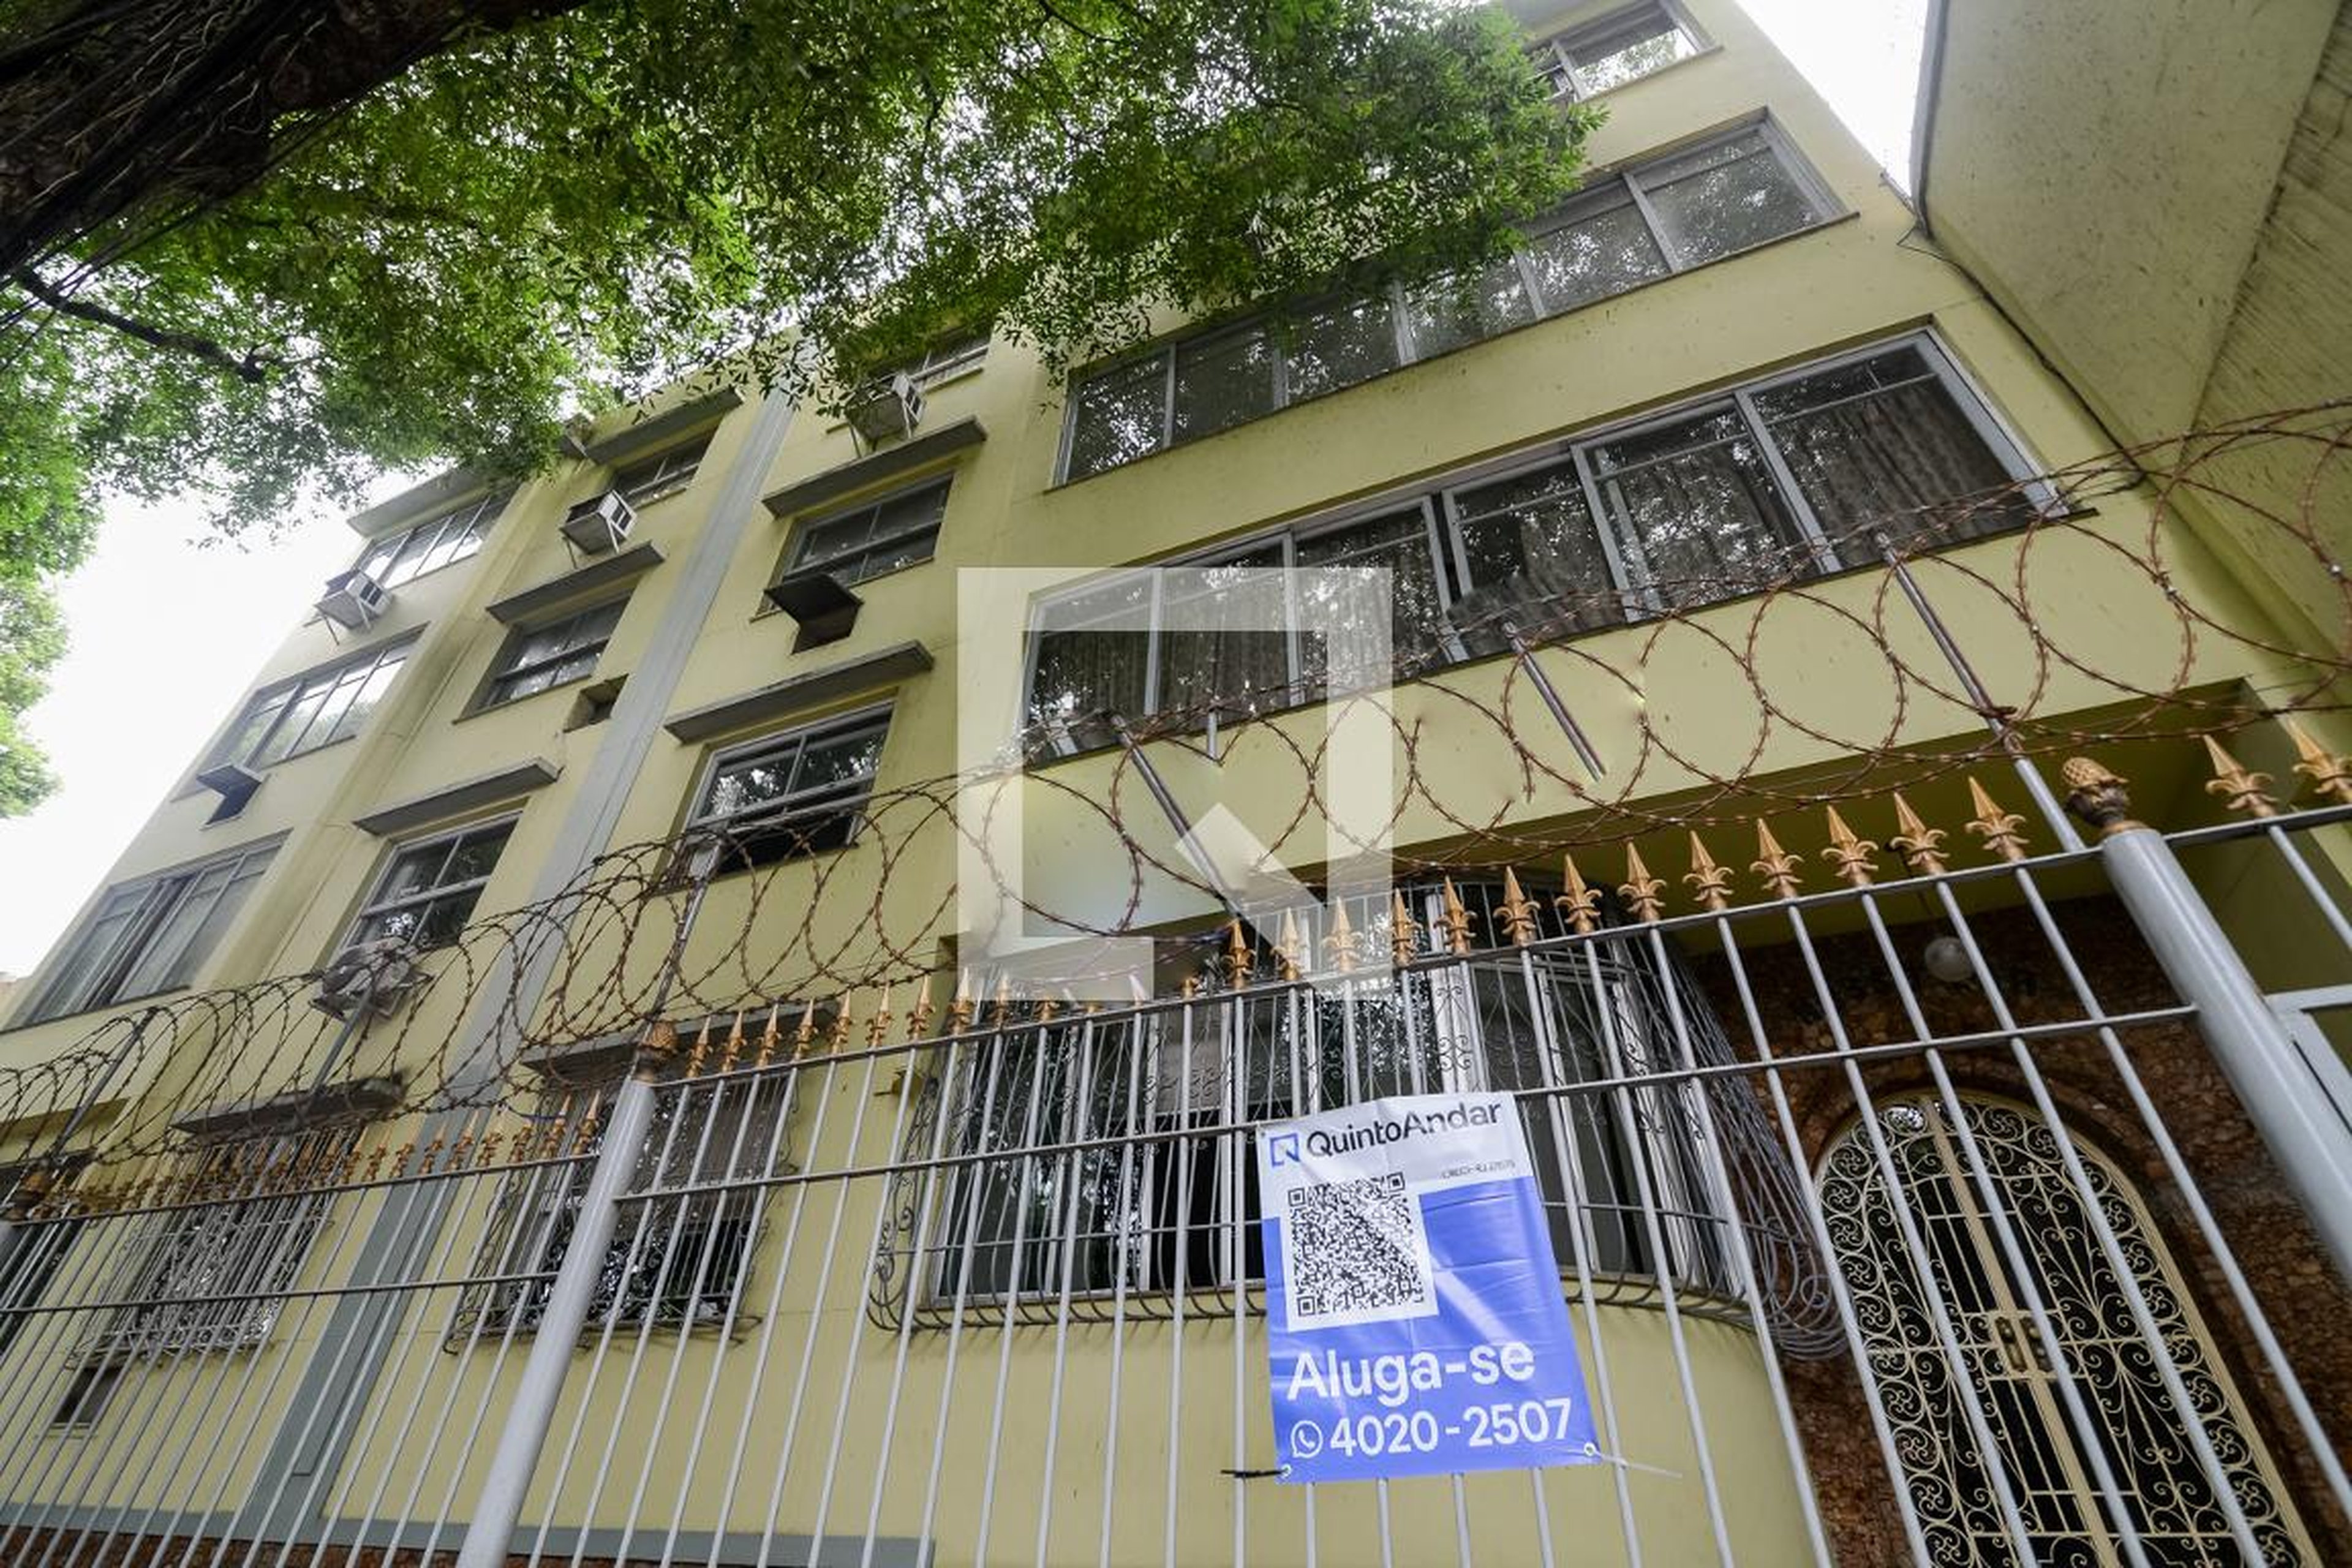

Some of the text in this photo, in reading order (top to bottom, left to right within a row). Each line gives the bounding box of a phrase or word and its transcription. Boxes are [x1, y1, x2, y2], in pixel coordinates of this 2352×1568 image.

[1306, 1102, 1502, 1158] QuintoAndar
[1287, 1341, 1536, 1407] Aluga-se
[1330, 1398, 1571, 1457] 4020-2507
